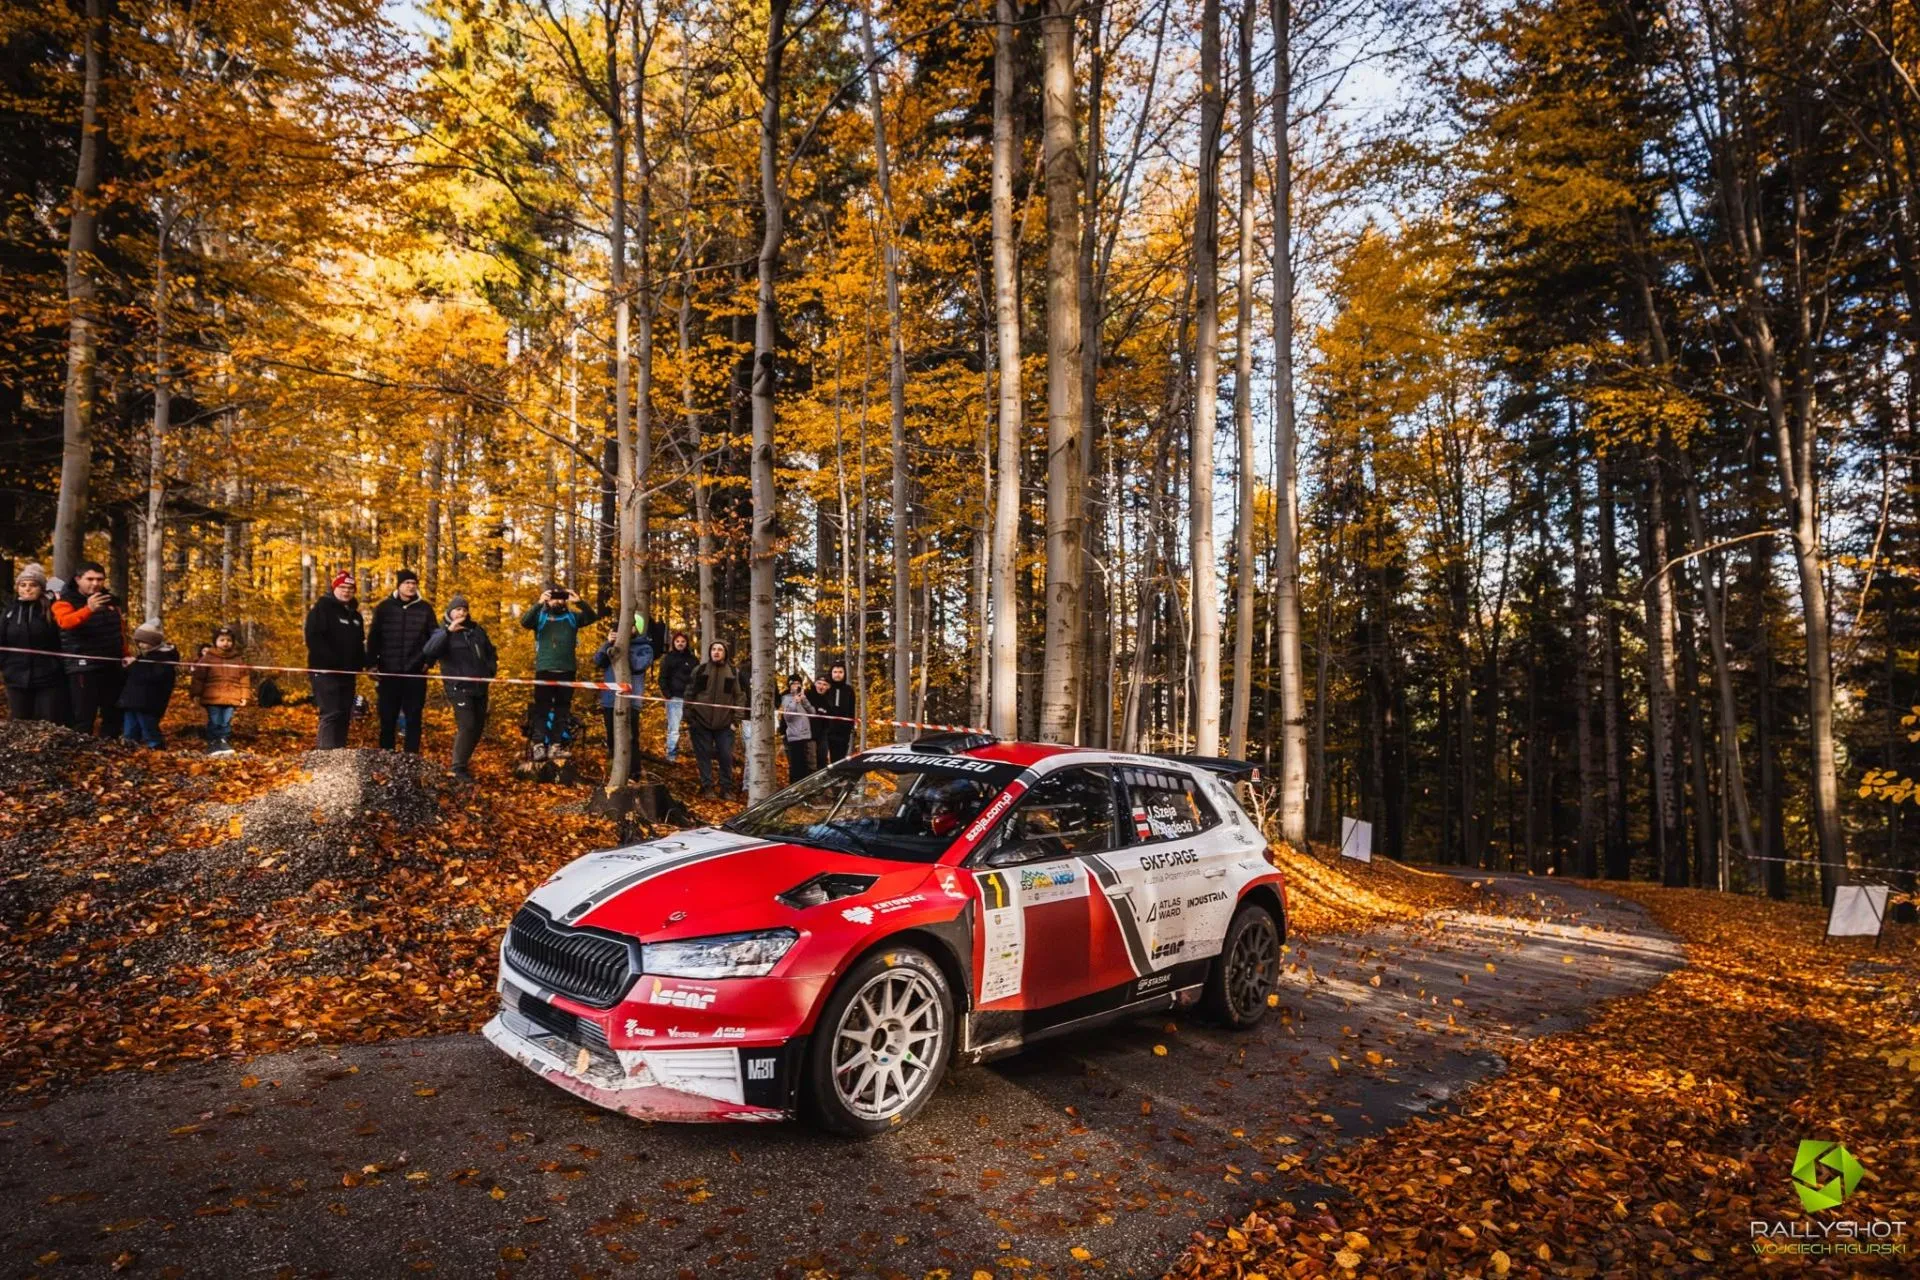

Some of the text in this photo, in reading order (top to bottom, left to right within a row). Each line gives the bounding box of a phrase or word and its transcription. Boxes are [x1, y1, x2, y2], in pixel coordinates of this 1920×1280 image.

[863, 755, 996, 773] KATOWICE.EU
[966, 792, 1013, 842] szeja.com.pl
[1140, 849, 1199, 871] GKFORGE
[987, 873, 1003, 909] 1
[1187, 890, 1228, 908] INDUSTRIA
[1159, 897, 1181, 909] ATLAS
[1159, 908, 1181, 920] WARD
